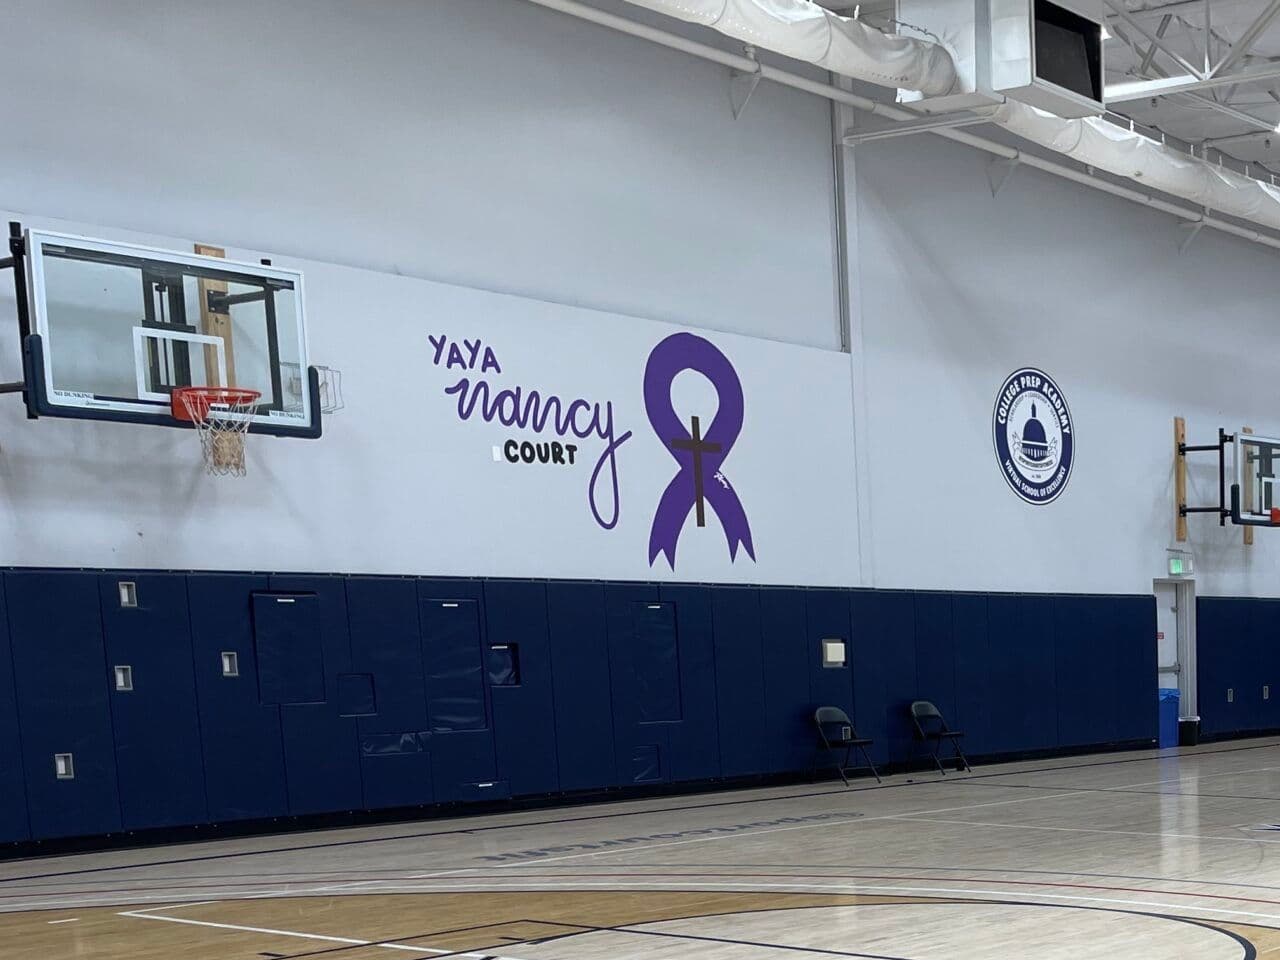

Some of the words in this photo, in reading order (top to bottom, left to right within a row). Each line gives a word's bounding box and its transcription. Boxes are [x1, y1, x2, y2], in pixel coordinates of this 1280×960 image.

[428, 335, 501, 373] YAYA
[998, 380, 1021, 424] COLLEGE
[1020, 376, 1041, 388] PREP
[1042, 382, 1070, 434] ACADEMY
[504, 439, 578, 465] COURT
